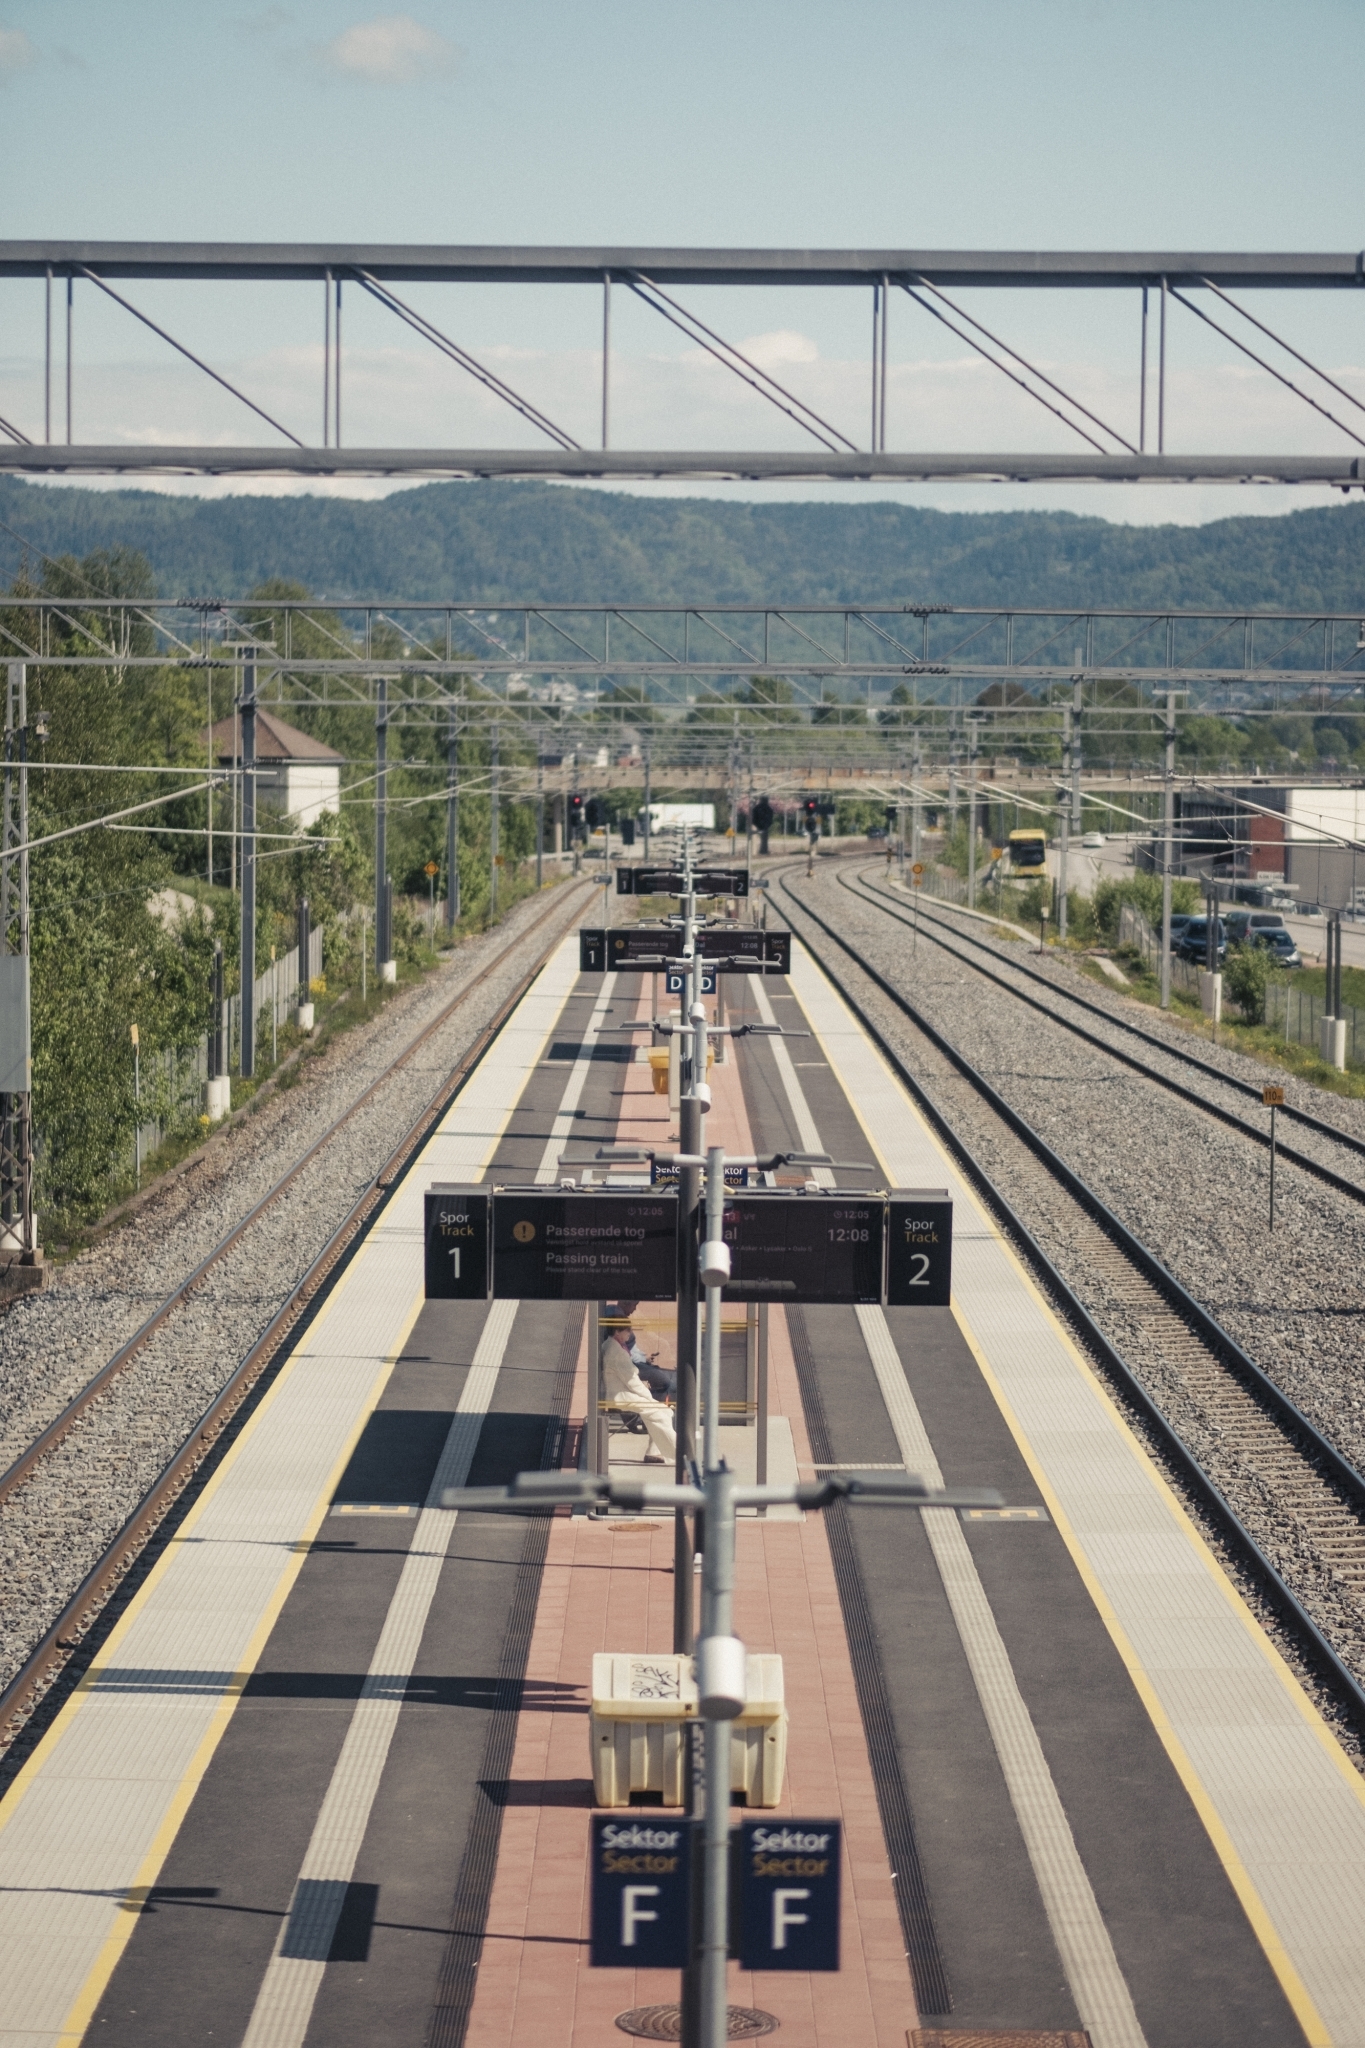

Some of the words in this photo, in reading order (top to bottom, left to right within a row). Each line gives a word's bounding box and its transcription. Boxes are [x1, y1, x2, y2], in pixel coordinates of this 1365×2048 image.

[589, 950, 595, 964] 1
[670, 976, 682, 990] D
[701, 976, 712, 990] D
[724, 1167, 744, 1175] ktor
[724, 1176, 742, 1184] ctor
[440, 1211, 470, 1226] Spor
[638, 1207, 663, 1216] 12:05
[844, 1210, 869, 1219] 12:05
[440, 1225, 475, 1236] Track
[546, 1225, 621, 1237] Passerende
[625, 1226, 645, 1239] tog
[904, 1218, 935, 1232] Spor
[724, 1227, 737, 1240] al
[828, 1229, 869, 1241] 12:08
[904, 1231, 939, 1243] Track
[448, 1247, 460, 1279] 1
[546, 1252, 597, 1267] Passing
[600, 1253, 629, 1265] train
[908, 1253, 930, 1285] 2
[601, 1824, 681, 1849] Sektor
[751, 1827, 832, 1852] Sektor
[602, 1850, 679, 1874] Sector
[752, 1853, 829, 1877] Sector
[622, 1884, 660, 1947] F
[772, 1887, 811, 1950] F
